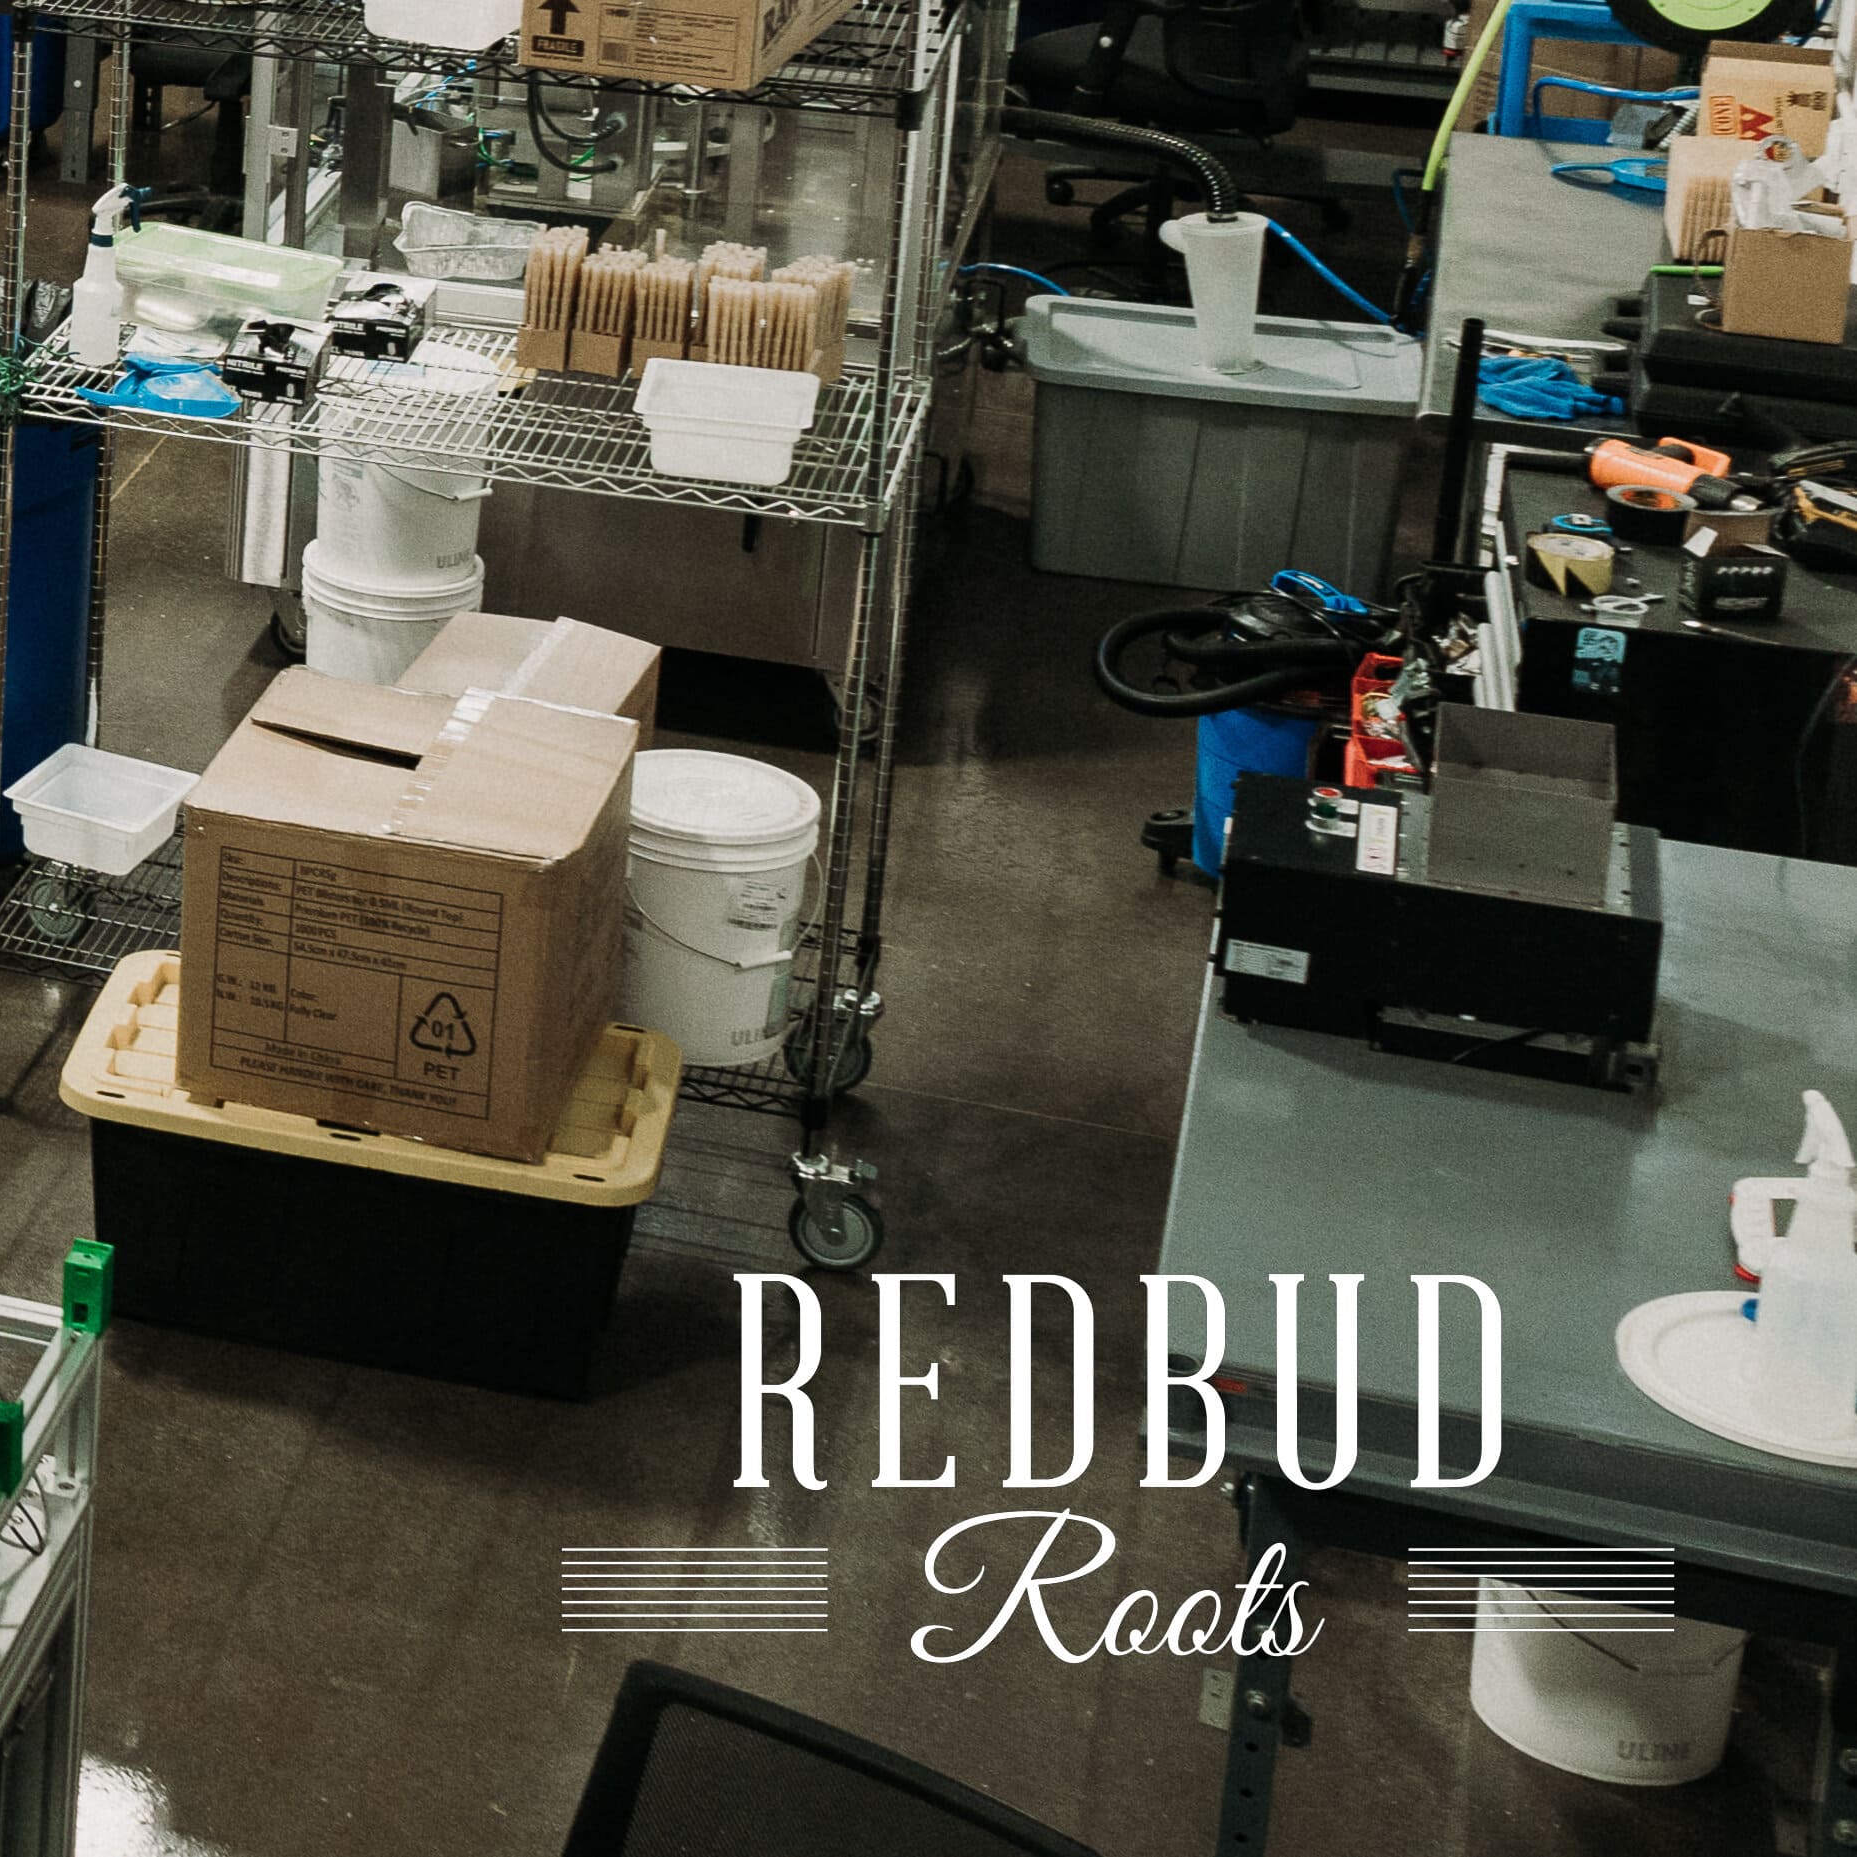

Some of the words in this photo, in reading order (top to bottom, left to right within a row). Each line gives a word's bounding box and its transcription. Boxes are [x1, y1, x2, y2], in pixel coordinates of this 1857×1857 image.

[1714, 97, 1735, 134] CONE
[330, 321, 364, 331] NITRILE
[226, 358, 264, 371] NITRILE
[296, 885, 313, 897] PET
[431, 1020, 454, 1040] 01
[239, 1056, 277, 1073] PLEASE
[279, 1064, 324, 1082] HANDLE
[325, 1074, 355, 1085] WITH
[389, 1085, 427, 1102] THANK
[423, 1061, 461, 1081] PET
